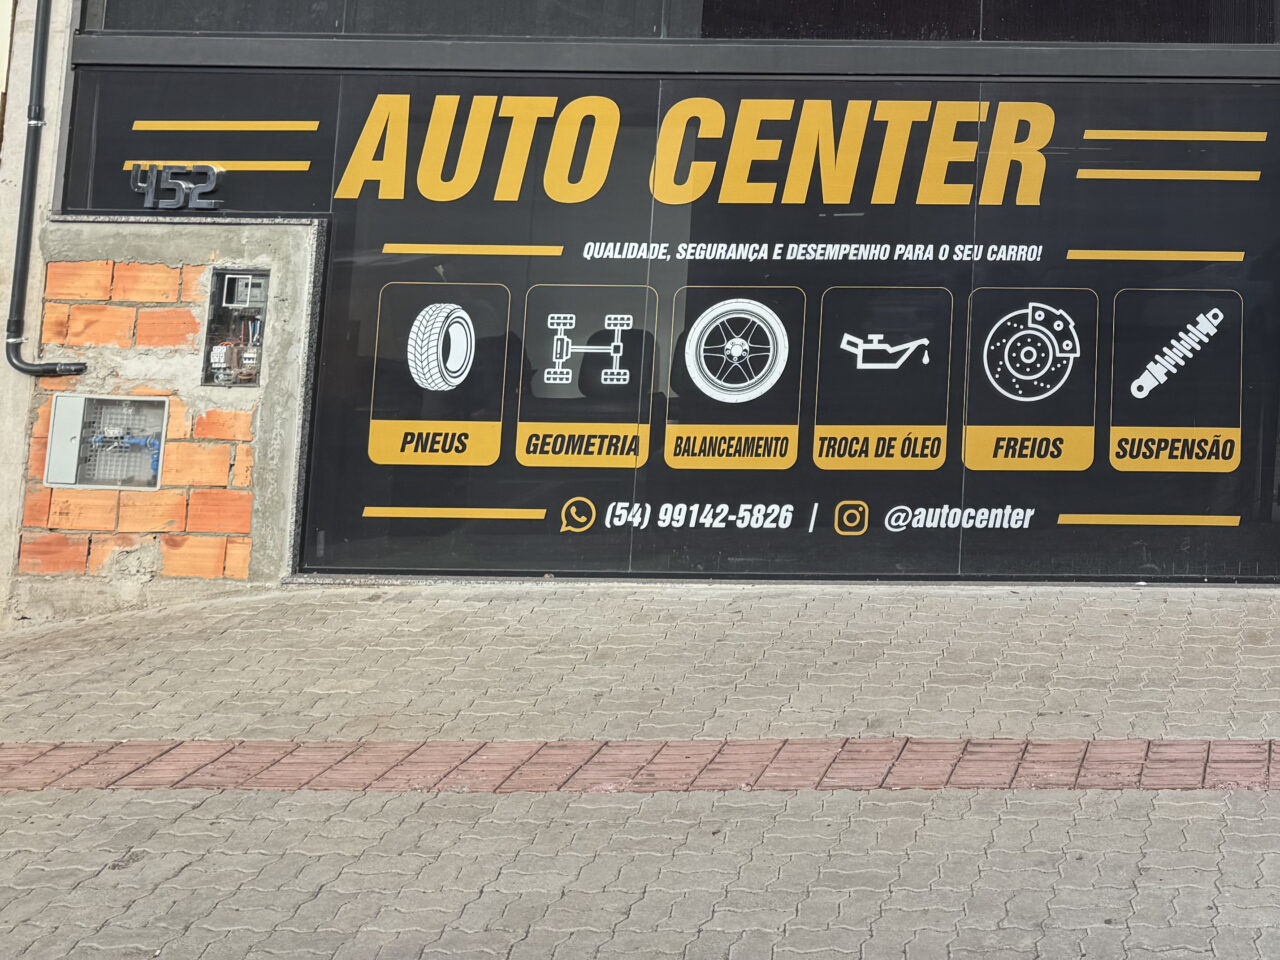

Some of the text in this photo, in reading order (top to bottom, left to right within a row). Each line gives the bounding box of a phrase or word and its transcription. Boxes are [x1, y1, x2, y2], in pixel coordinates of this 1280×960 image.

[334, 93, 1056, 207] AUTO CENTER
[130, 163, 224, 209] 452
[582, 241, 1043, 263] QUALIDADE, SEGURANÇA E DESEMPENHO PARA O SEU CARRO!
[400, 431, 470, 454] PNEUS
[524, 434, 641, 457] GEOMETRIA
[672, 436, 790, 458] BALANCEAMENTO
[817, 431, 942, 459] TROCA DE ÓLEO
[992, 437, 1065, 459] FREIOS
[1114, 433, 1236, 461] SUSPENSÃO
[604, 501, 652, 531] (54)
[657, 503, 795, 530] 99142-5826
[884, 504, 1036, 532] @autocenter
